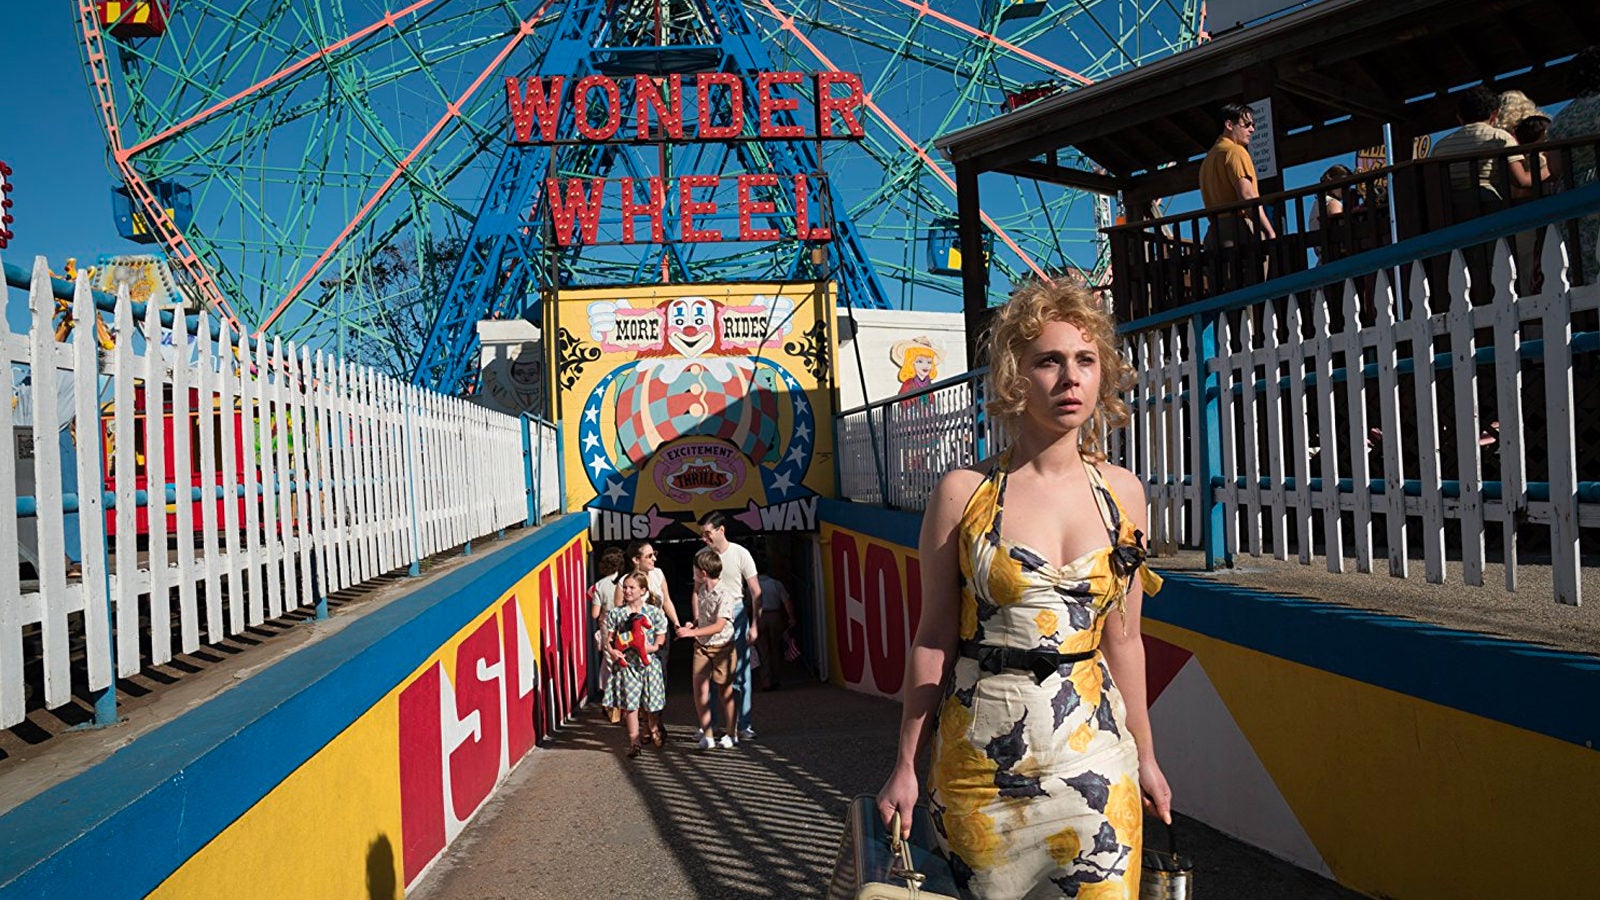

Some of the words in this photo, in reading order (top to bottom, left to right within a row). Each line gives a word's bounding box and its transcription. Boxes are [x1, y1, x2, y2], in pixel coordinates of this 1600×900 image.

[505, 71, 865, 142] WONDER
[546, 173, 832, 246] WHEEL
[615, 317, 660, 341] MORE
[722, 315, 769, 340] RIDES
[666, 446, 734, 460] EXCITEMENT
[675, 471, 725, 488] THRILLS
[586, 506, 650, 541] THIS
[760, 495, 820, 531] WAY
[400, 538, 588, 890] ISLAND
